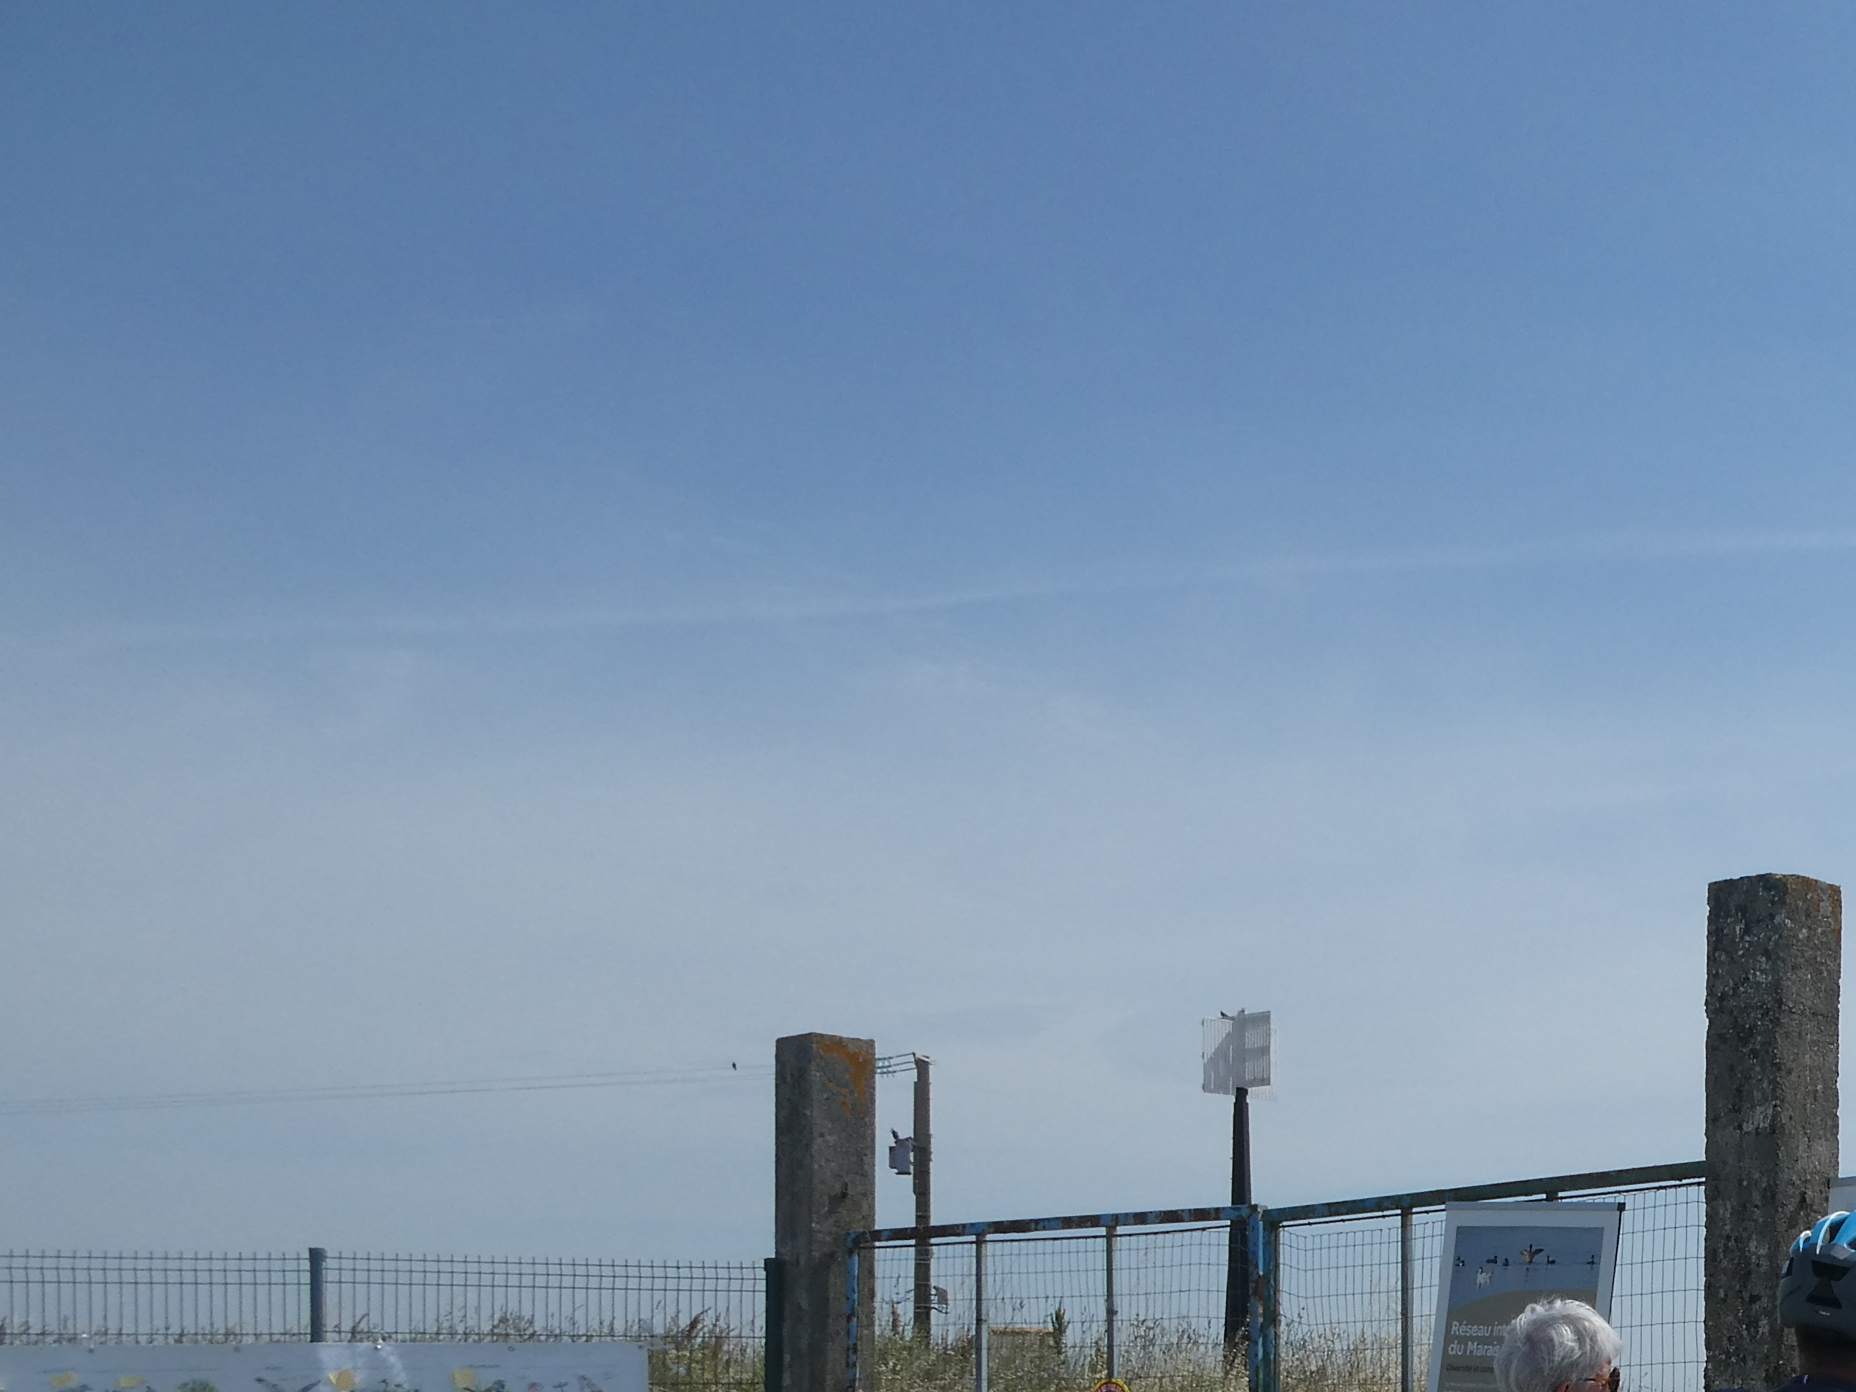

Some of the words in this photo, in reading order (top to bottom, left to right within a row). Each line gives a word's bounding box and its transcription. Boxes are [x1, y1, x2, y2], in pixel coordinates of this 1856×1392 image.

[1451, 1320, 1491, 1336] Réseau
[1448, 1339, 1464, 1355] du
[1466, 1341, 1501, 1356] Marais
